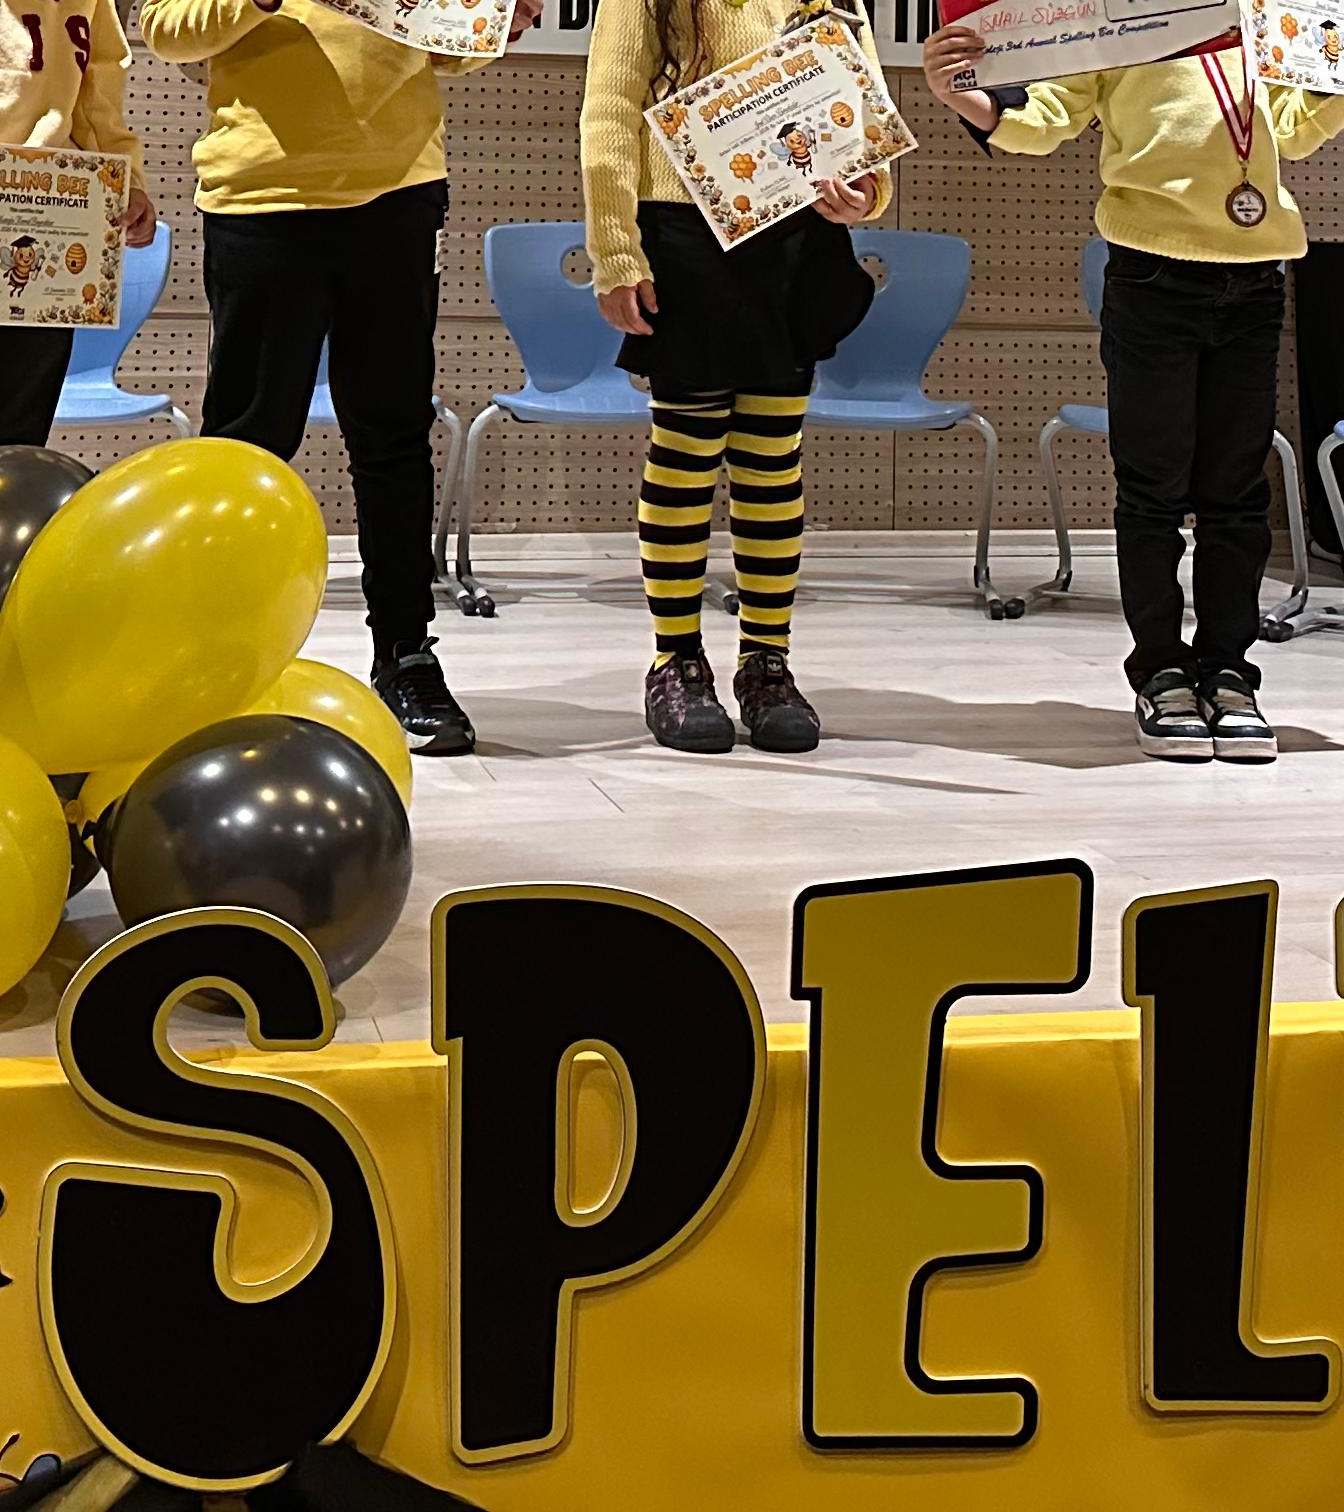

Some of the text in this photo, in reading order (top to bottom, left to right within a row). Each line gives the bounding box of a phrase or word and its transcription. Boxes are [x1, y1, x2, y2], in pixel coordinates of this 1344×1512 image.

[699, 67, 783, 125] SPELLING
[782, 50, 820, 78] BEE
[706, 91, 773, 133] PARTICIPATION
[772, 64, 826, 97] CERTIFICATE
[35, 195, 89, 209] CERTIFICATE
[57, 174, 90, 198] BEE
